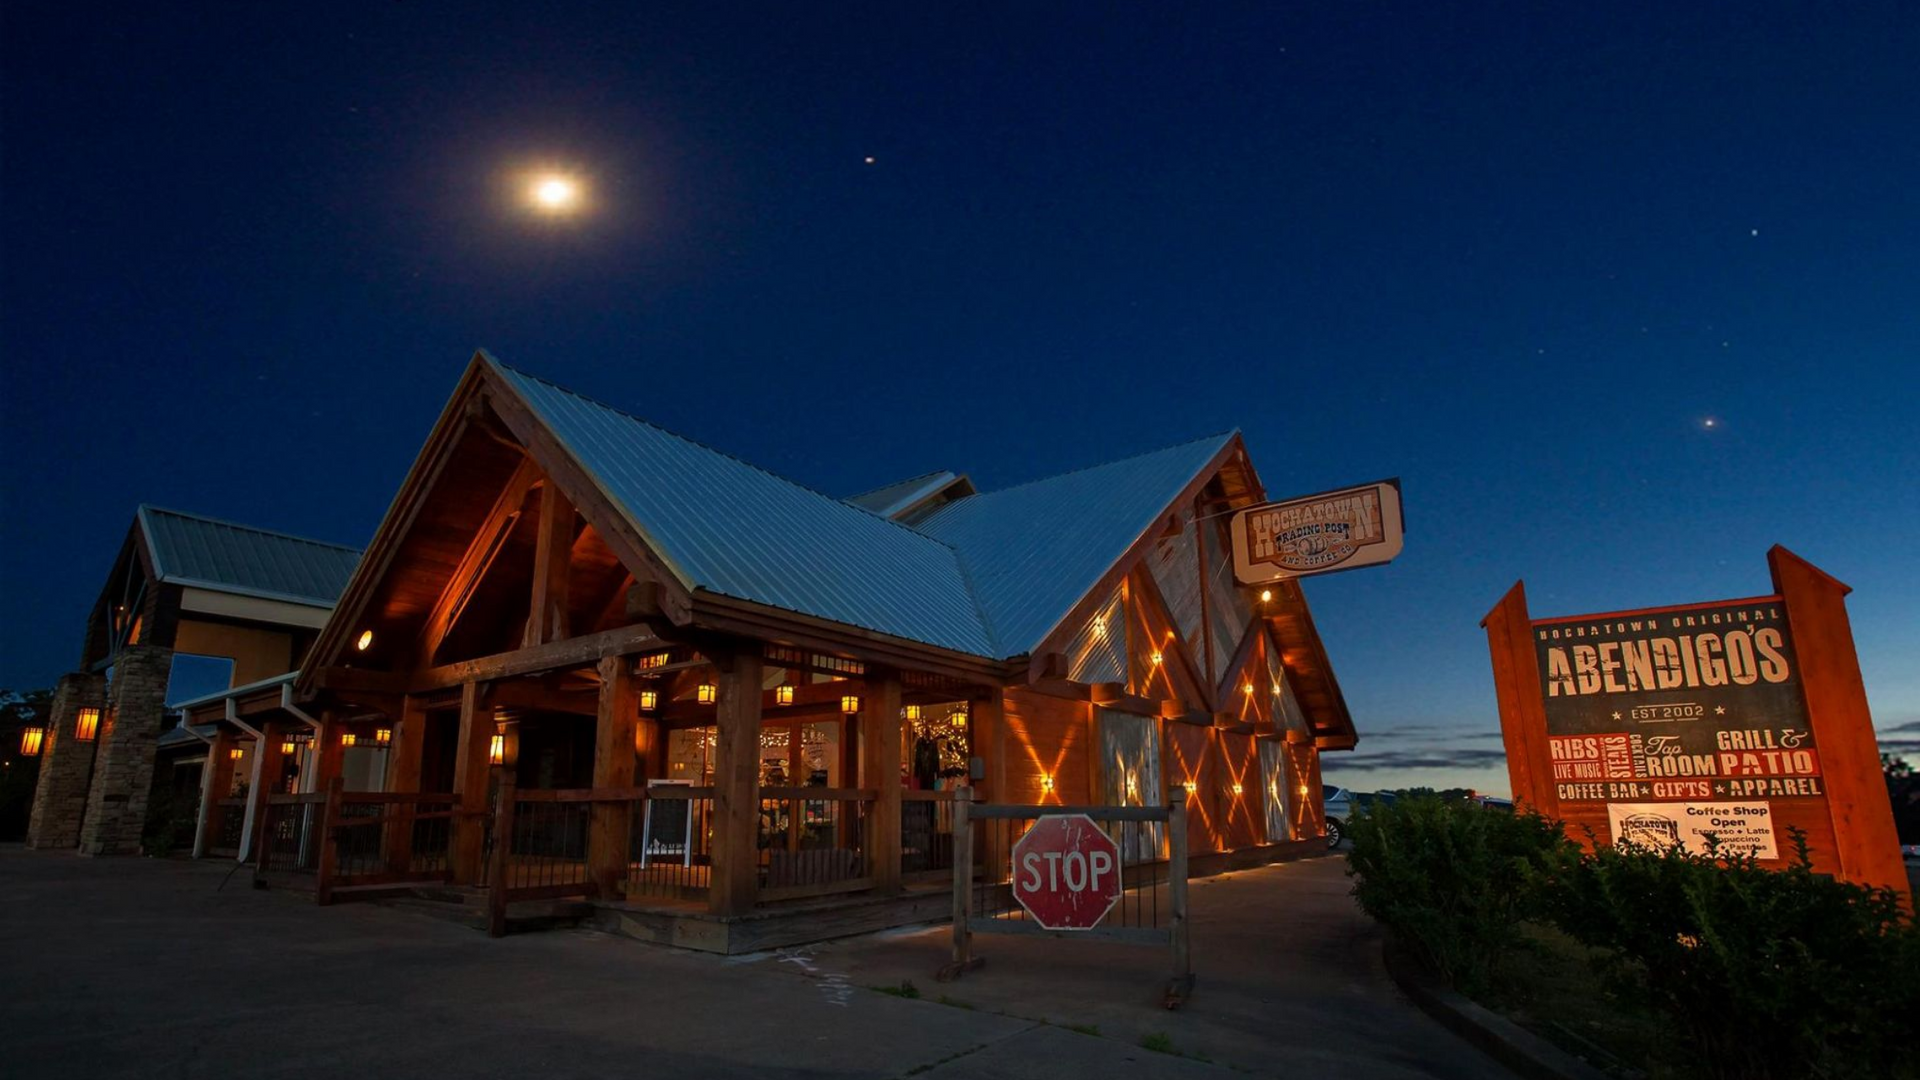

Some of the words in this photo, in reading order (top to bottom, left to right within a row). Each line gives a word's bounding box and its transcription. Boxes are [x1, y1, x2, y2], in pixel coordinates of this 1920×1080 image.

[1252, 494, 1374, 558] HOCHATOWN
[1276, 524, 1320, 551] TRADING
[1325, 523, 1349, 540] POST
[1281, 555, 1300, 565] AND
[1304, 552, 1338, 565] COFFEE
[1539, 619, 1657, 640] HOCHATOWN
[1672, 608, 1779, 628] ORIGINAL
[1548, 624, 1791, 697] ABENDIGO'S
[1631, 708, 1657, 720] EST
[1663, 706, 1704, 718] 2002
[1550, 737, 1599, 760] RIBS
[1644, 735, 1682, 757] Tap
[1716, 729, 1778, 750] GRILL
[1780, 728, 1808, 749] &
[1604, 736, 1632, 778] STEAKS
[1629, 733, 1648, 778] COCKTAILS
[1646, 754, 1717, 777] ROOM
[1720, 750, 1814, 776] PATIO
[1553, 763, 1573, 779] LIVE
[1574, 762, 1602, 778] MUSIC
[1558, 783, 1605, 799] COFFEE
[1609, 782, 1639, 798] BAR
[1653, 781, 1710, 798] GIFTS
[1730, 778, 1822, 796] APPAREL
[1686, 807, 1730, 816] Coffee
[1733, 806, 1768, 817] Shop
[1711, 818, 1746, 828] Open
[1022, 851, 1112, 892] STOP
